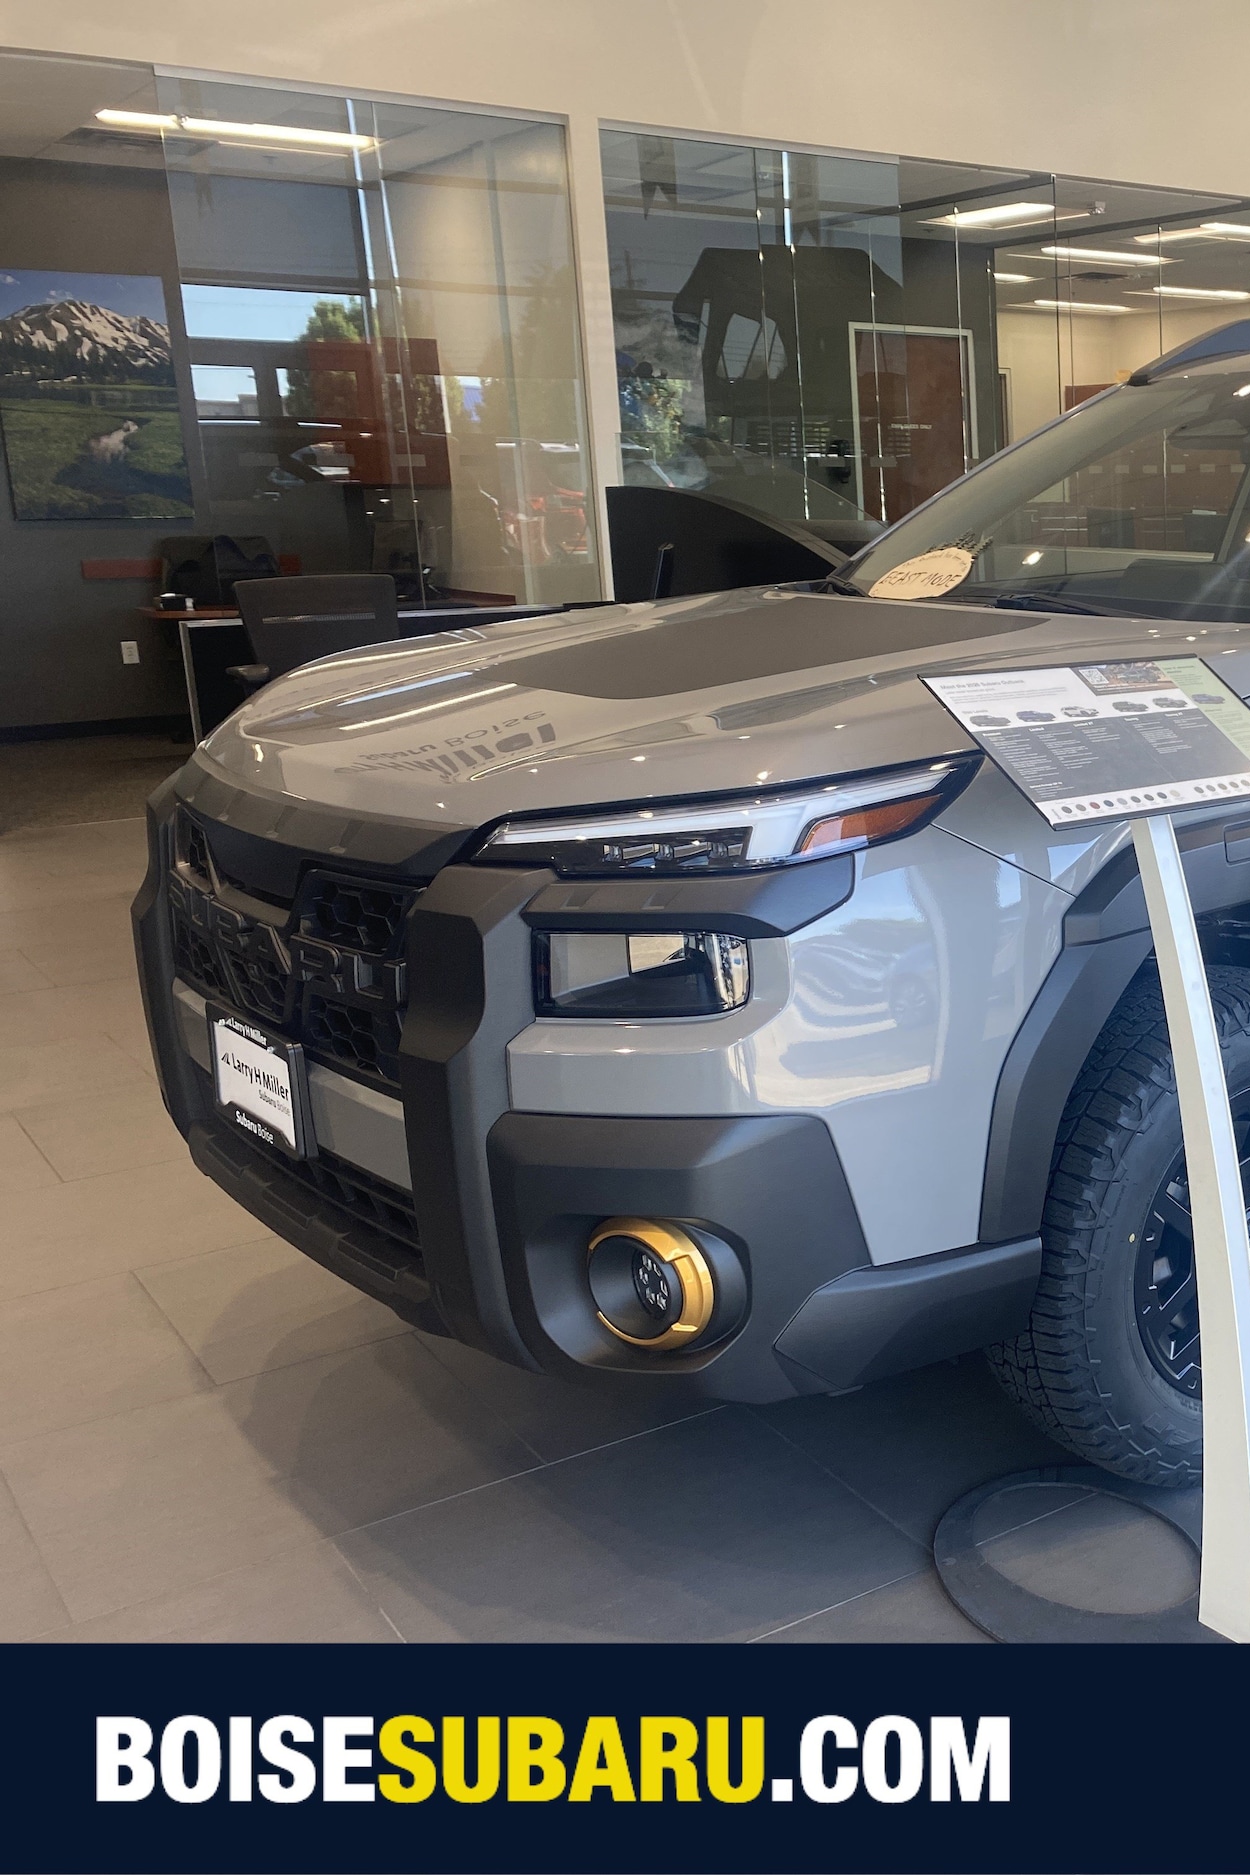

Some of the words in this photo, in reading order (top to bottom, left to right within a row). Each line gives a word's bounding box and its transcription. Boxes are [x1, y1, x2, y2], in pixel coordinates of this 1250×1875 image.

[920, 573, 962, 588] MODE
[168, 869, 407, 1008] SUBARU
[231, 1053, 255, 1085] Larry
[254, 1066, 262, 1085] H
[262, 1072, 289, 1101] Miller
[258, 1089, 277, 1108] Subaru
[235, 1110, 258, 1134] Subaru
[257, 1123, 274, 1145] Boise
